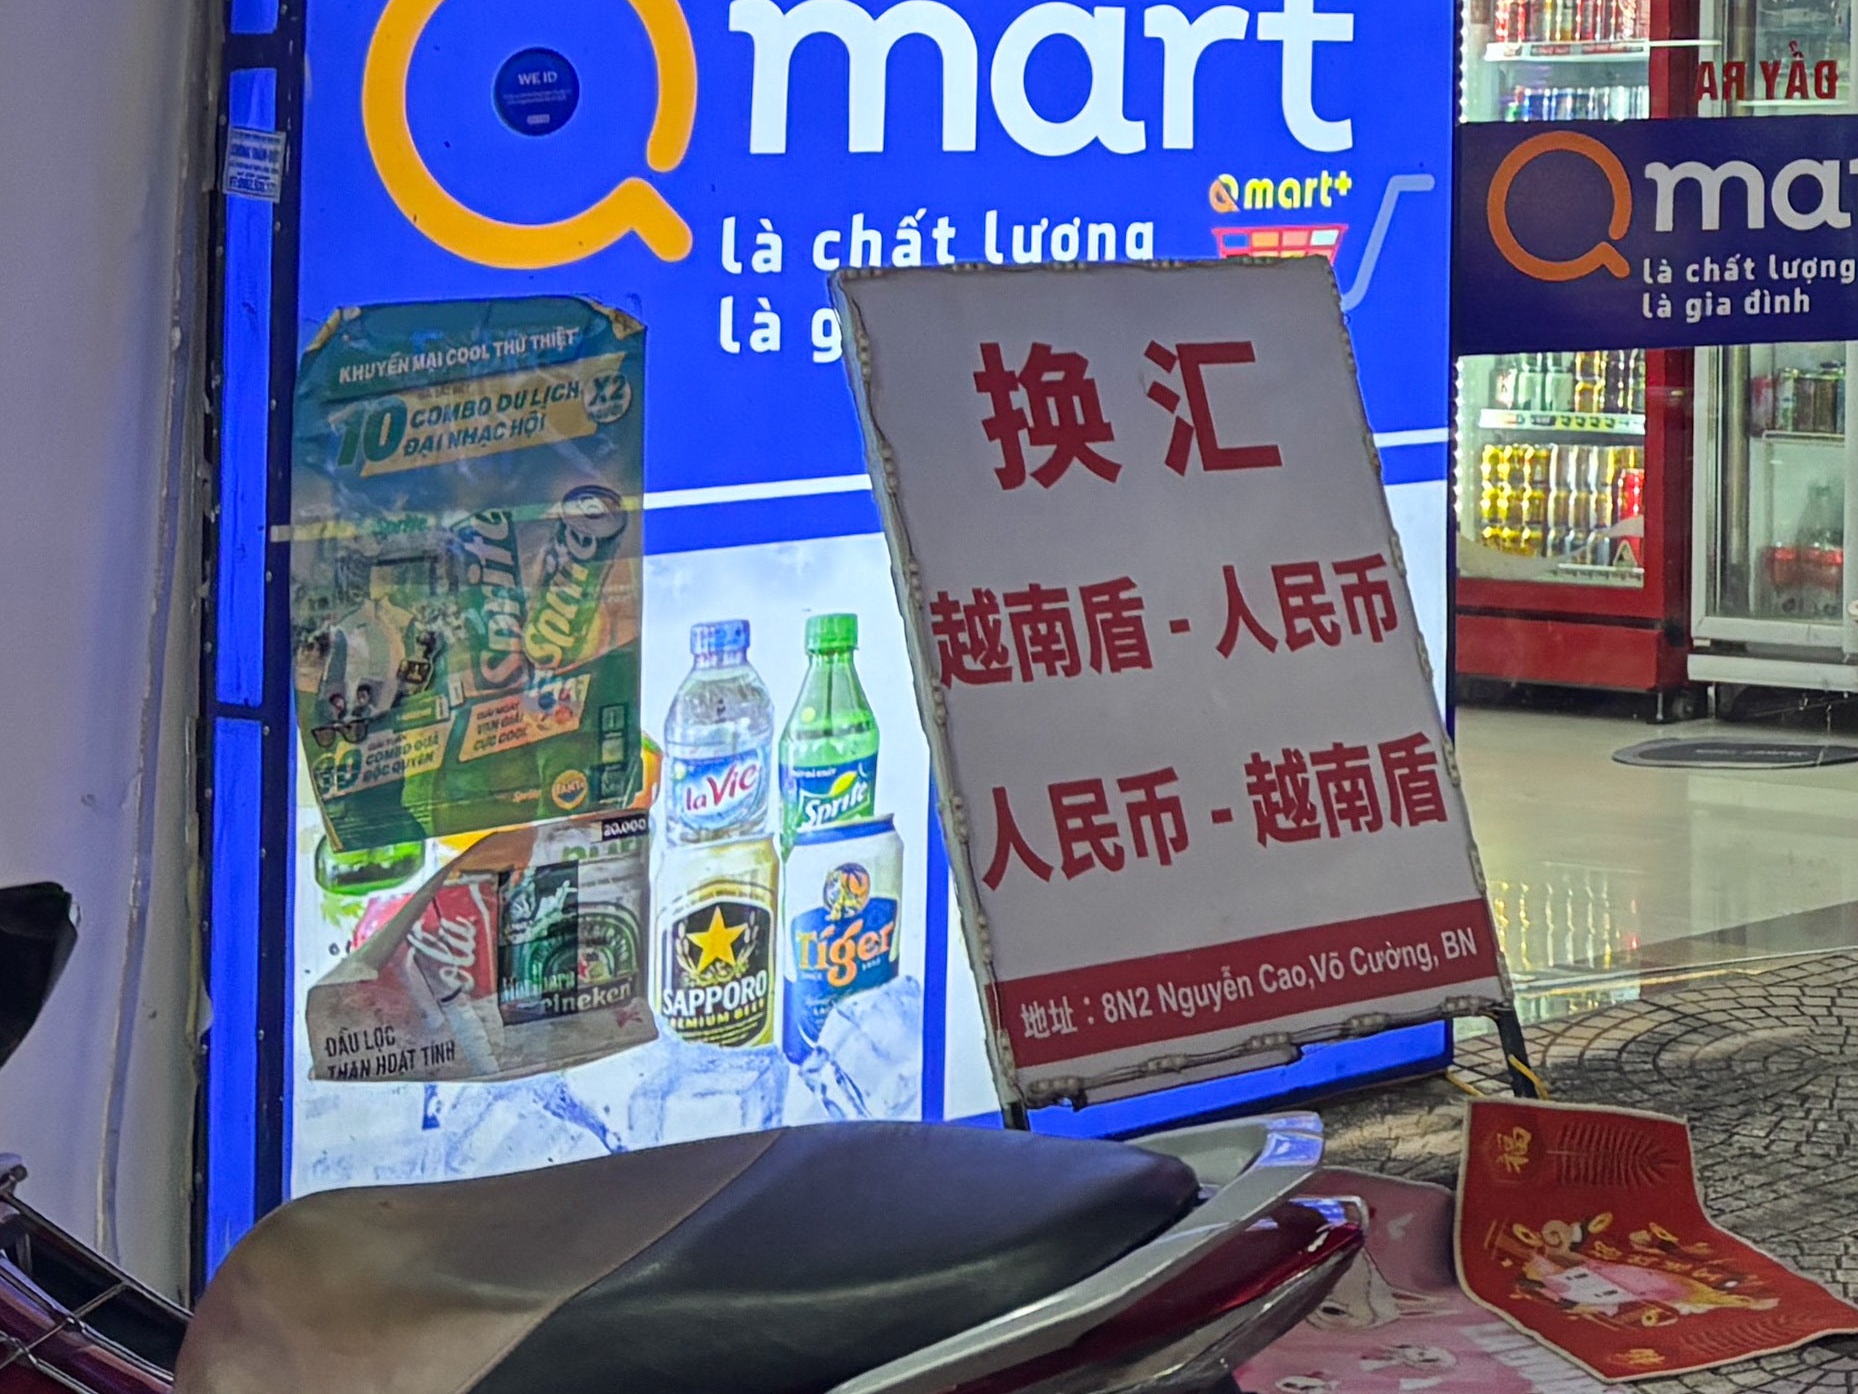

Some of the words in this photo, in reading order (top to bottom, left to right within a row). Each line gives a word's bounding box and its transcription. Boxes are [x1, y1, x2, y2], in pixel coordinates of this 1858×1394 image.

[720, 214, 783, 275] là
[811, 208, 957, 270] chất
[1643, 257, 1673, 284] là
[1686, 253, 1755, 284] chất
[1769, 255, 1857, 285] lượng
[718, 295, 782, 355] là
[1643, 292, 1673, 319] là
[1686, 292, 1732, 324] gia
[1744, 287, 1811, 317] đình
[972, 340, 1283, 492] 换汇
[930, 574, 1154, 693] 越南盾
[1216, 553, 1400, 663] 人民币
[982, 766, 1189, 893] 人民币
[1243, 732, 1450, 849] 越南盾
[795, 918, 895, 988] Tiger
[1101, 985, 1153, 1024] 8N2
[1157, 967, 1255, 1019] Nguyễn
[1441, 927, 1478, 960] BN
[662, 969, 768, 1017] SAPPORO
